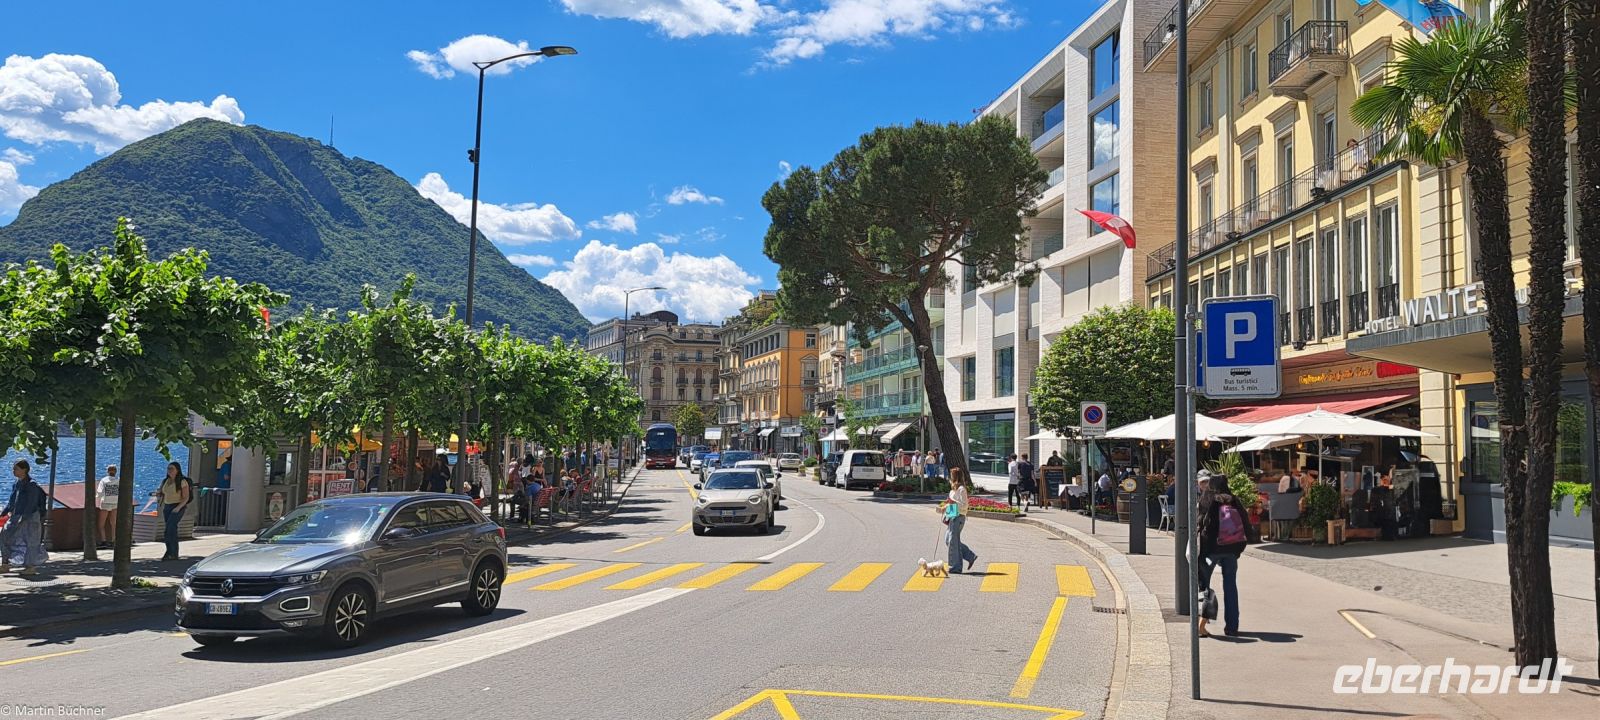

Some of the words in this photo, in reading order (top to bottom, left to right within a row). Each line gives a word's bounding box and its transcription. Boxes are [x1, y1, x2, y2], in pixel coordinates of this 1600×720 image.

[1365, 316, 1399, 334] HOTEL
[1403, 284, 1488, 326] WALTE
[1225, 312, 1257, 359] P
